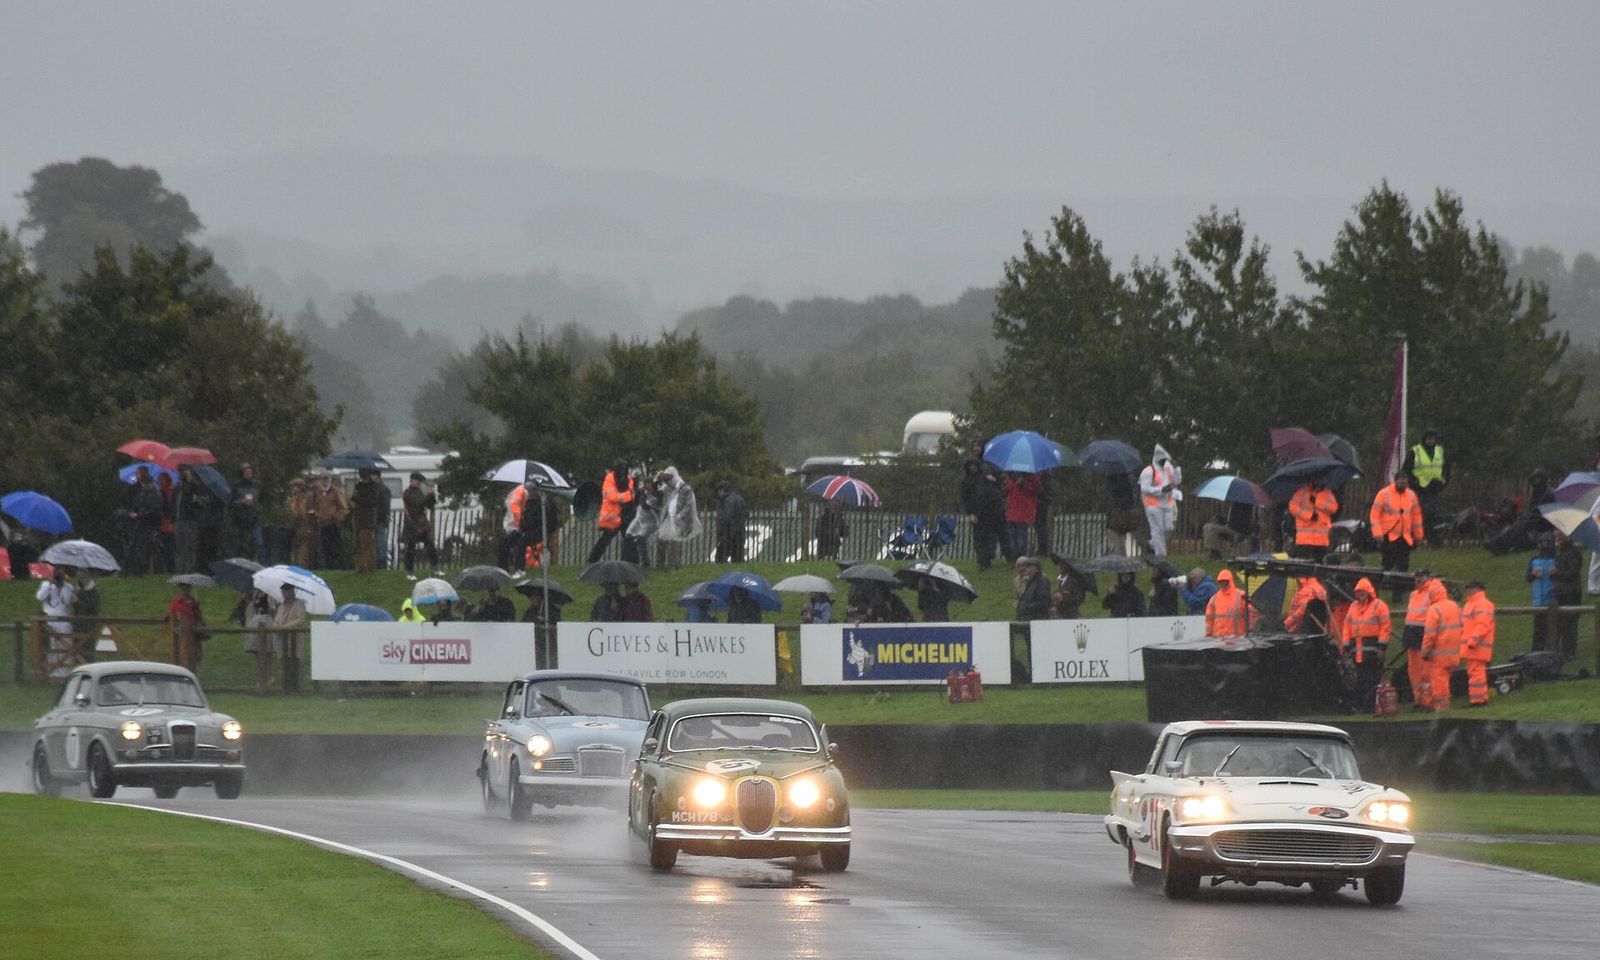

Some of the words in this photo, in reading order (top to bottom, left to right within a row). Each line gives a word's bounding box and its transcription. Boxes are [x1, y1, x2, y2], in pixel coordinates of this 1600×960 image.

[382, 641, 406, 662] sky
[411, 643, 468, 660] CINEMA
[587, 627, 651, 657] GIEVES
[656, 635, 669, 653] &
[674, 629, 746, 657] HAWKES
[877, 643, 968, 663] MICHELIN
[627, 669, 662, 678] SAVILE
[665, 669, 687, 678] ROW
[691, 669, 727, 679] LONDON
[1054, 660, 1110, 679] ROLEX
